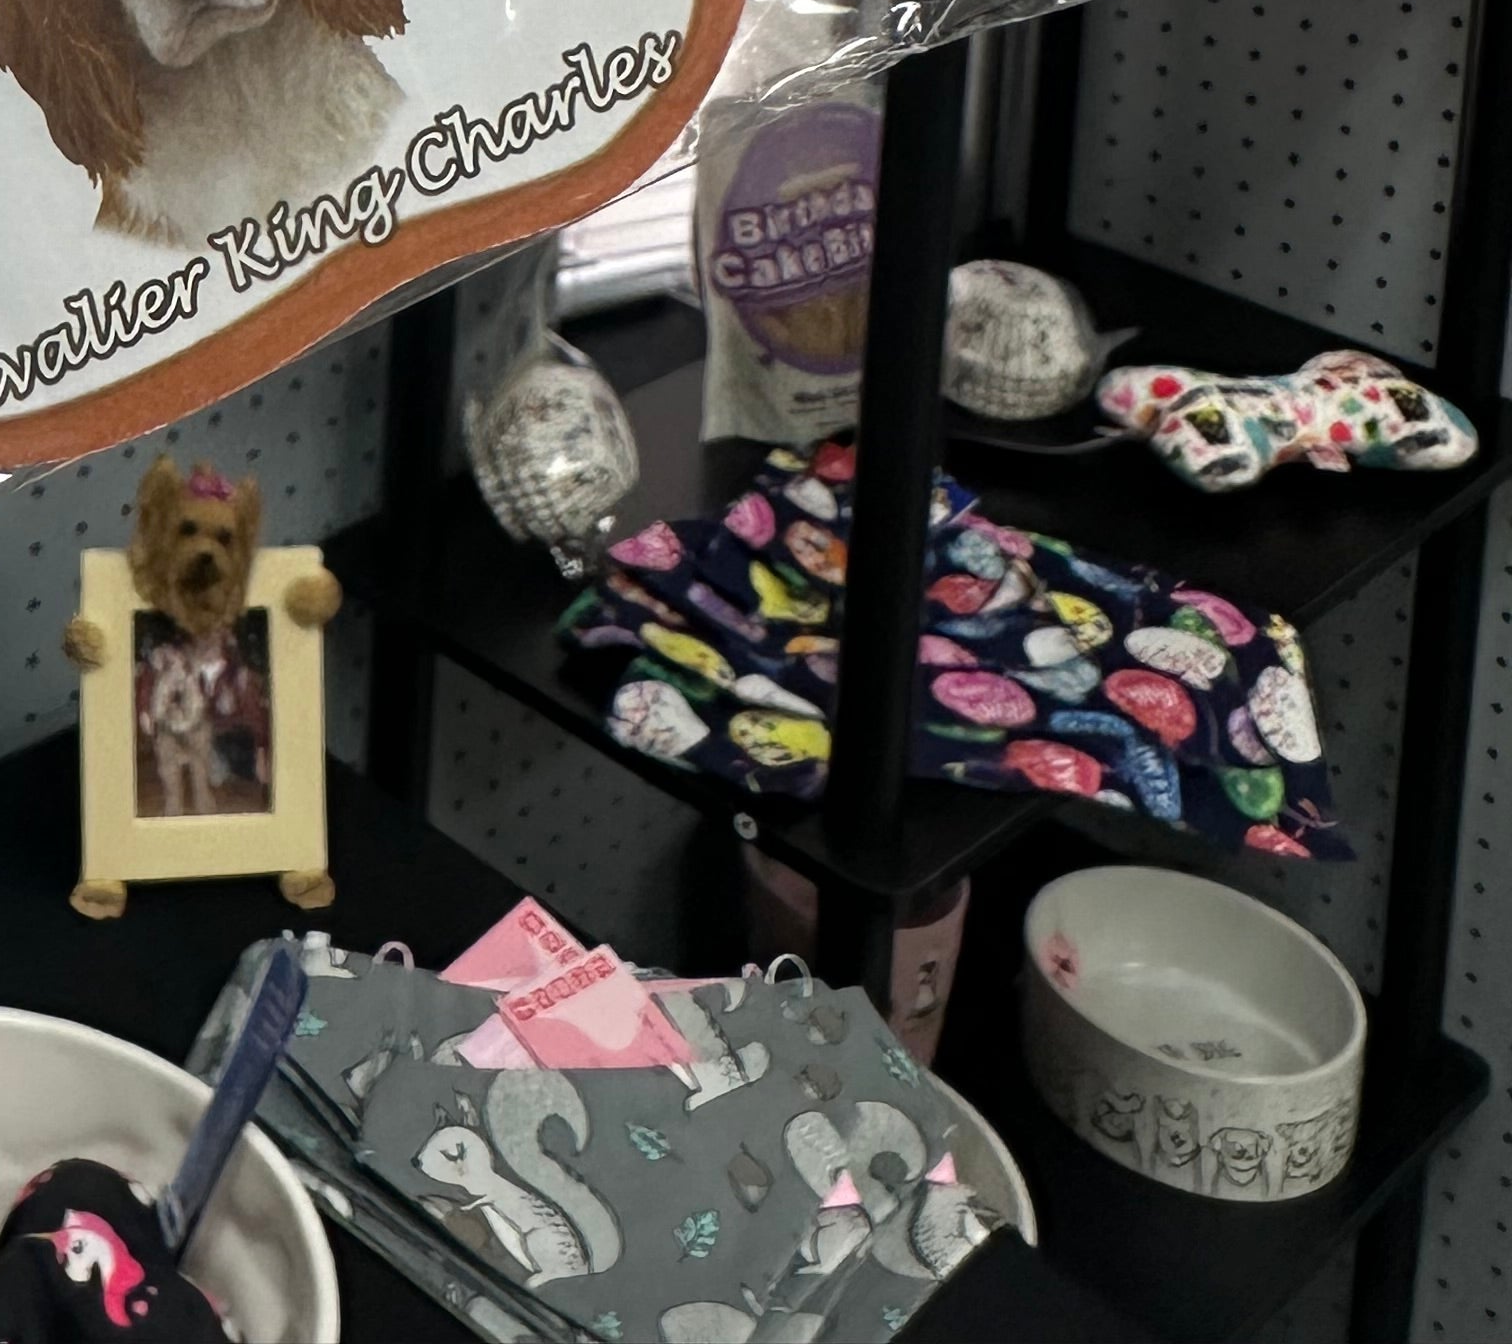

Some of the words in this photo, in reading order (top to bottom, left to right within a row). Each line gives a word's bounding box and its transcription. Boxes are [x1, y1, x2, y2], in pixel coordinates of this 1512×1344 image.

[209, 167, 404, 292] King
[406, 29, 682, 194] Charles
[728, 180, 874, 244] Birthda
